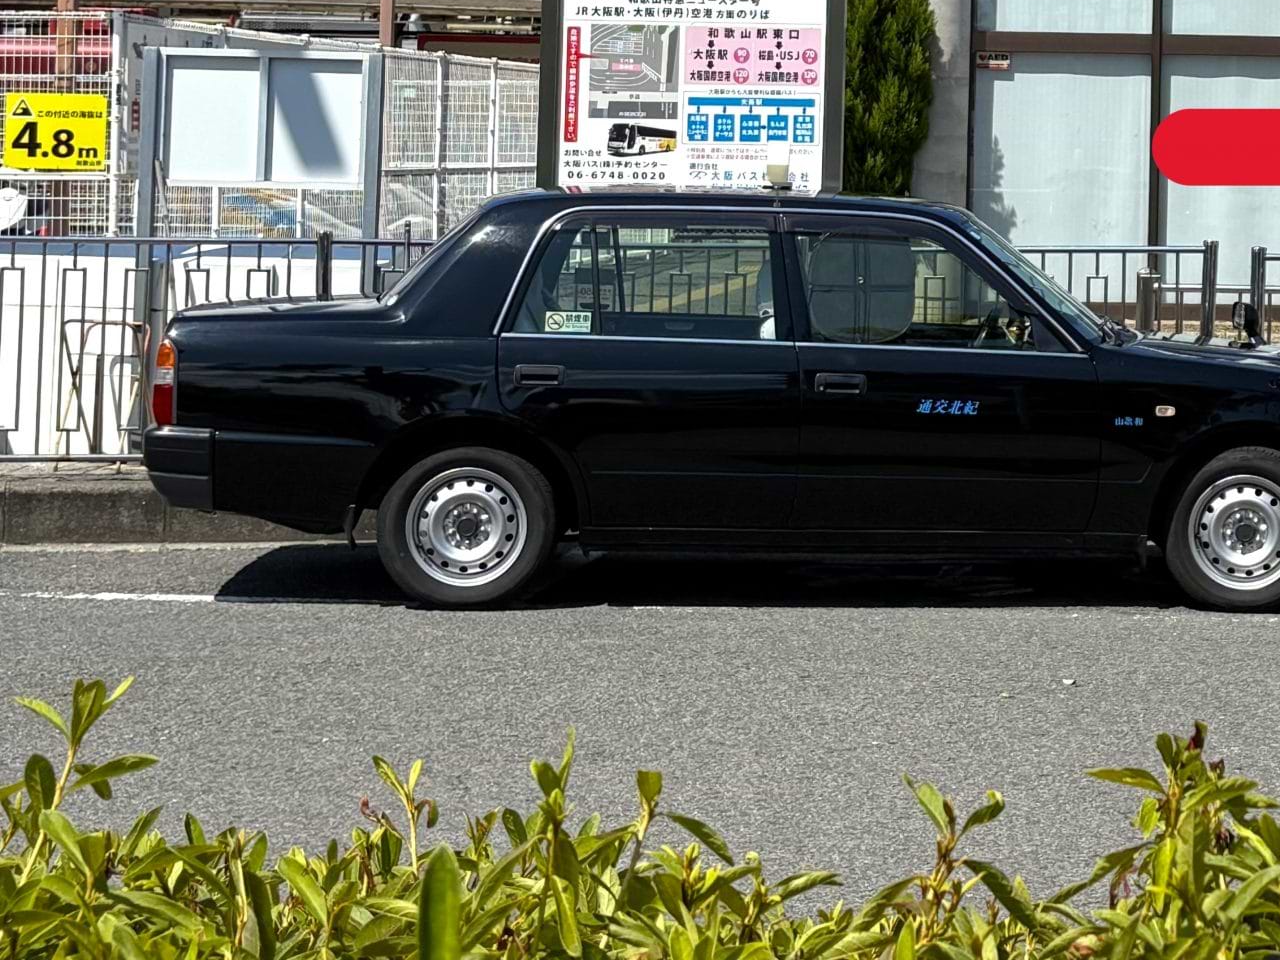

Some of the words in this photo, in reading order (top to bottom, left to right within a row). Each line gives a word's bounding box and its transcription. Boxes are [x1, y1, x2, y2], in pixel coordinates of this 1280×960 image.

[708, 27, 800, 40] 和歌山駅東口
[693, 49, 728, 60] 大阪駅
[37, 111, 103, 119] この付近の海抜は
[564, 149, 602, 157] お問い合せ
[567, 170, 666, 180] 06-6748-0020
